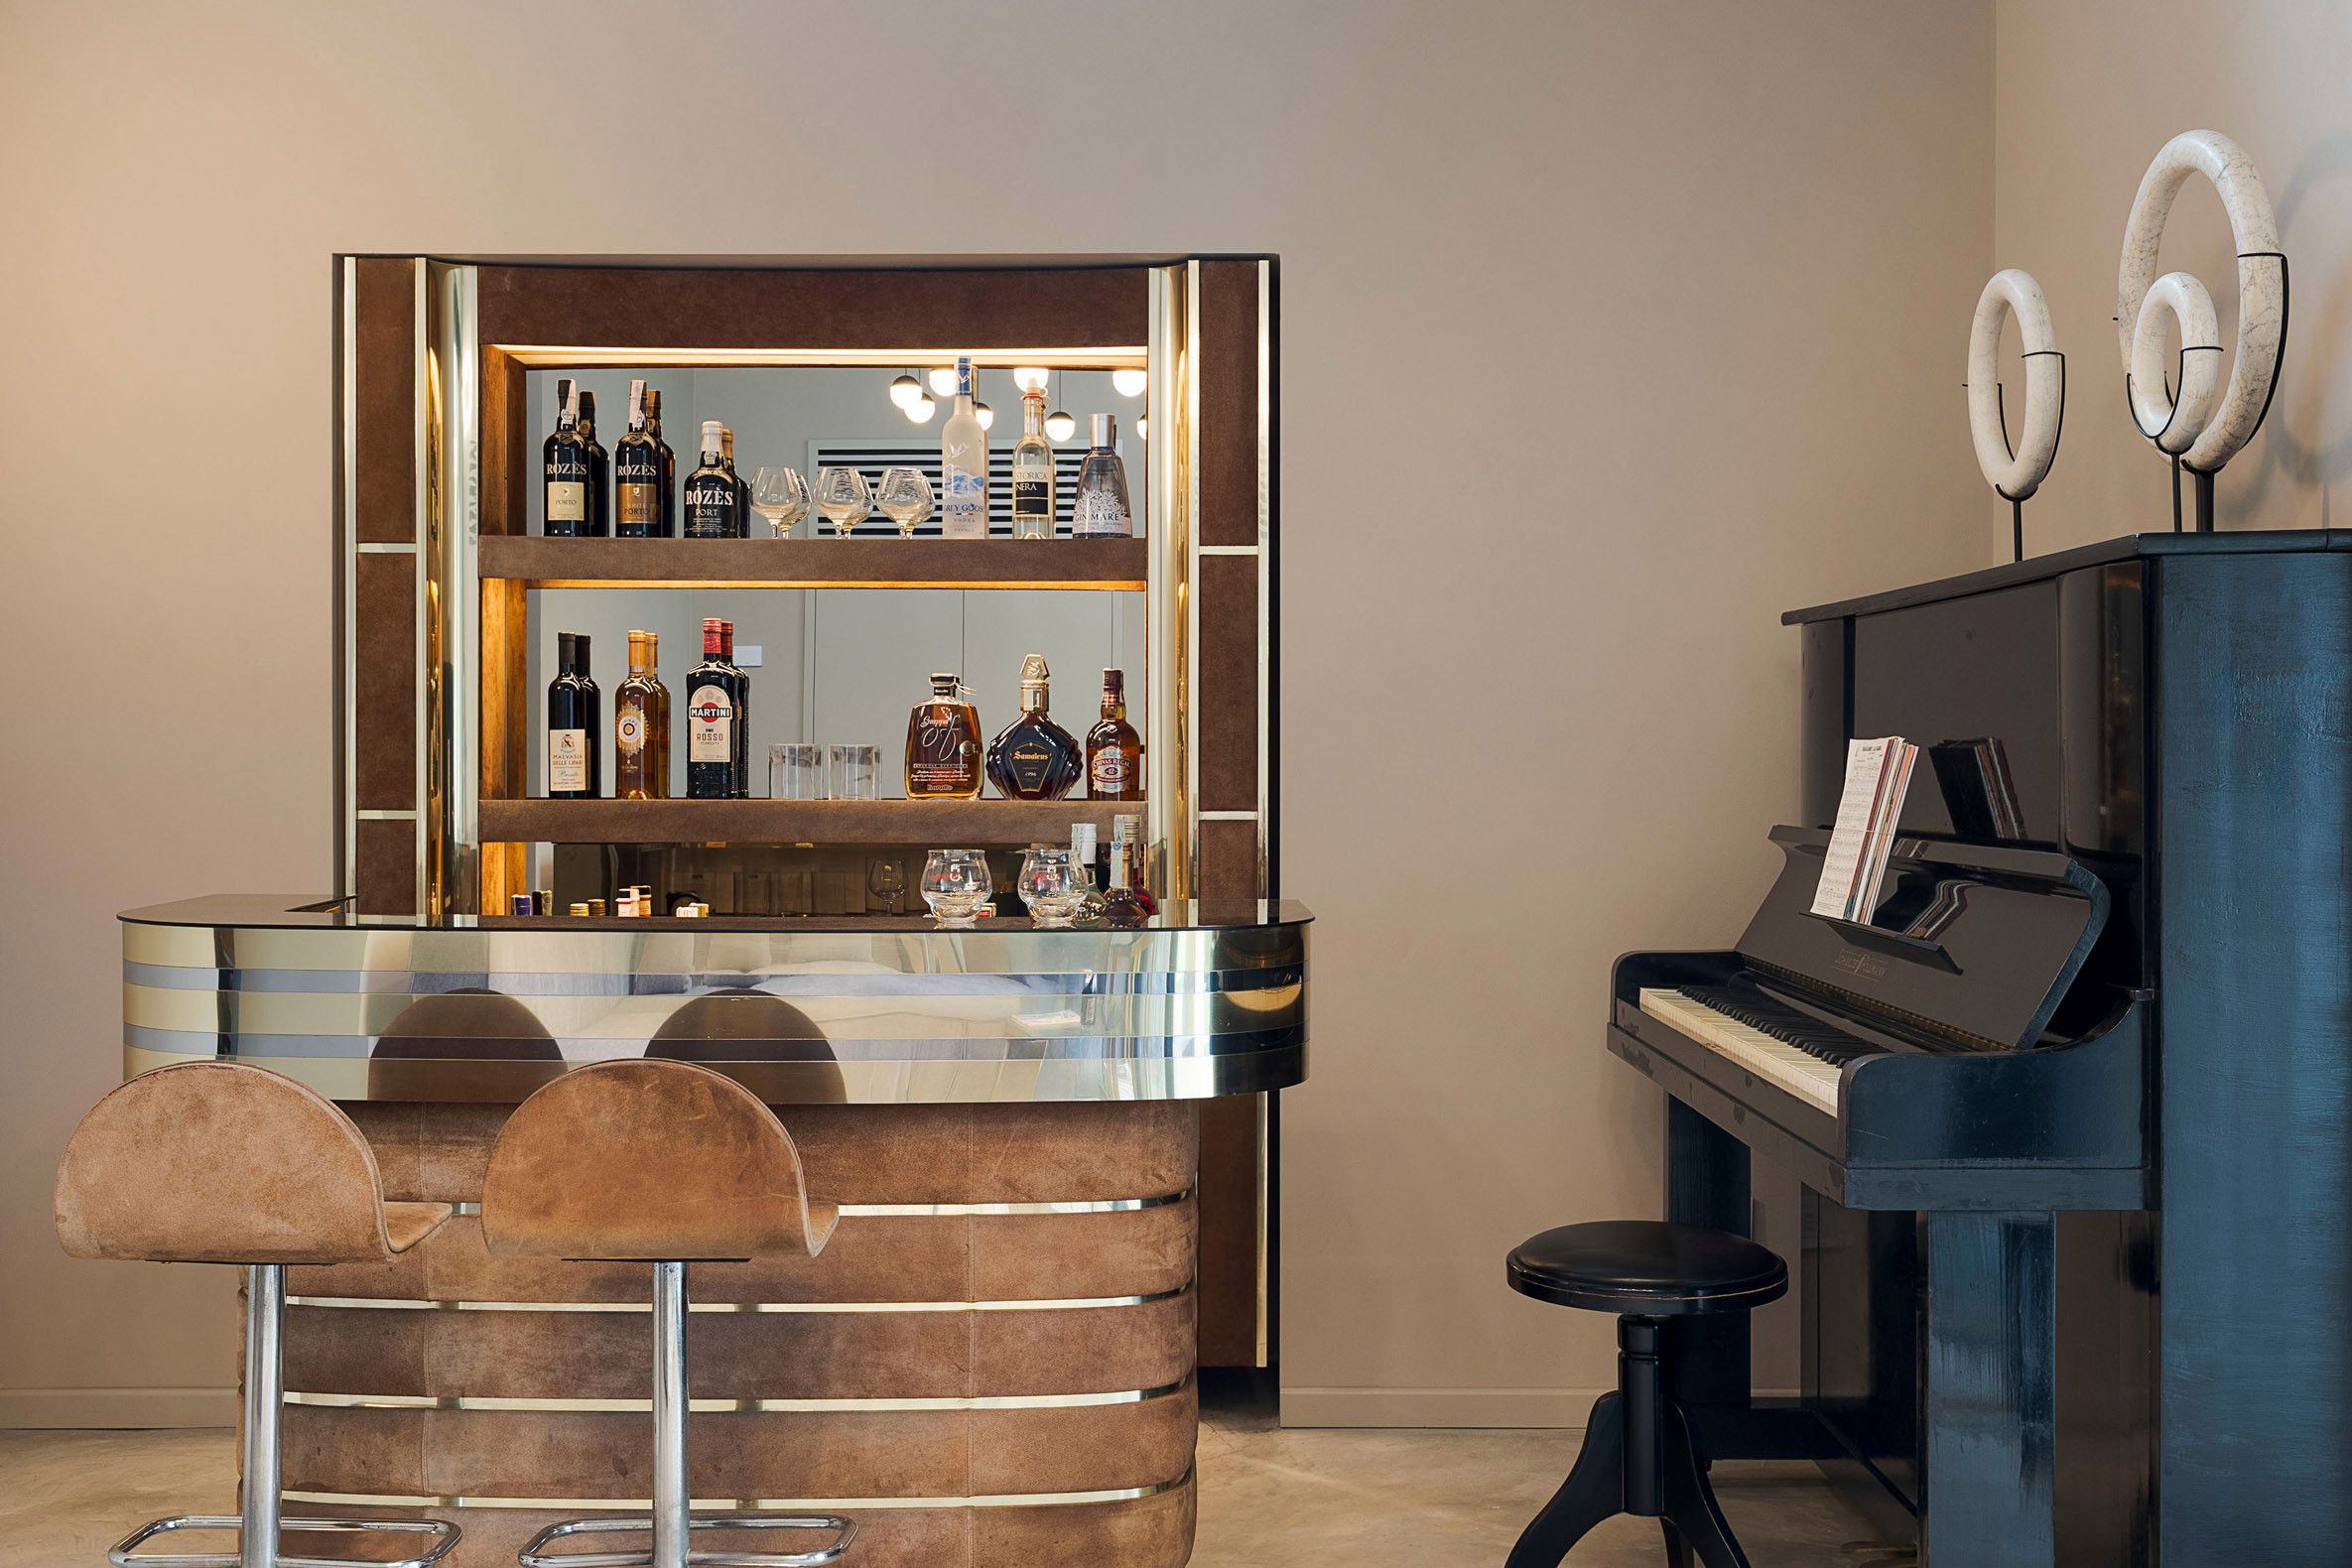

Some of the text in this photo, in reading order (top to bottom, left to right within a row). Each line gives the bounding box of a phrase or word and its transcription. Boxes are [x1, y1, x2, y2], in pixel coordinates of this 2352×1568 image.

[547, 460, 588, 475] ROZÈS
[617, 461, 657, 476] ROZÈS
[1016, 482, 1037, 491] NERA
[686, 486, 733, 506] ROZÈS
[696, 507, 719, 517] PORT
[1075, 512, 1119, 522] GIN MARE
[691, 708, 730, 718] MARTINI
[697, 732, 723, 741] ROSSO
